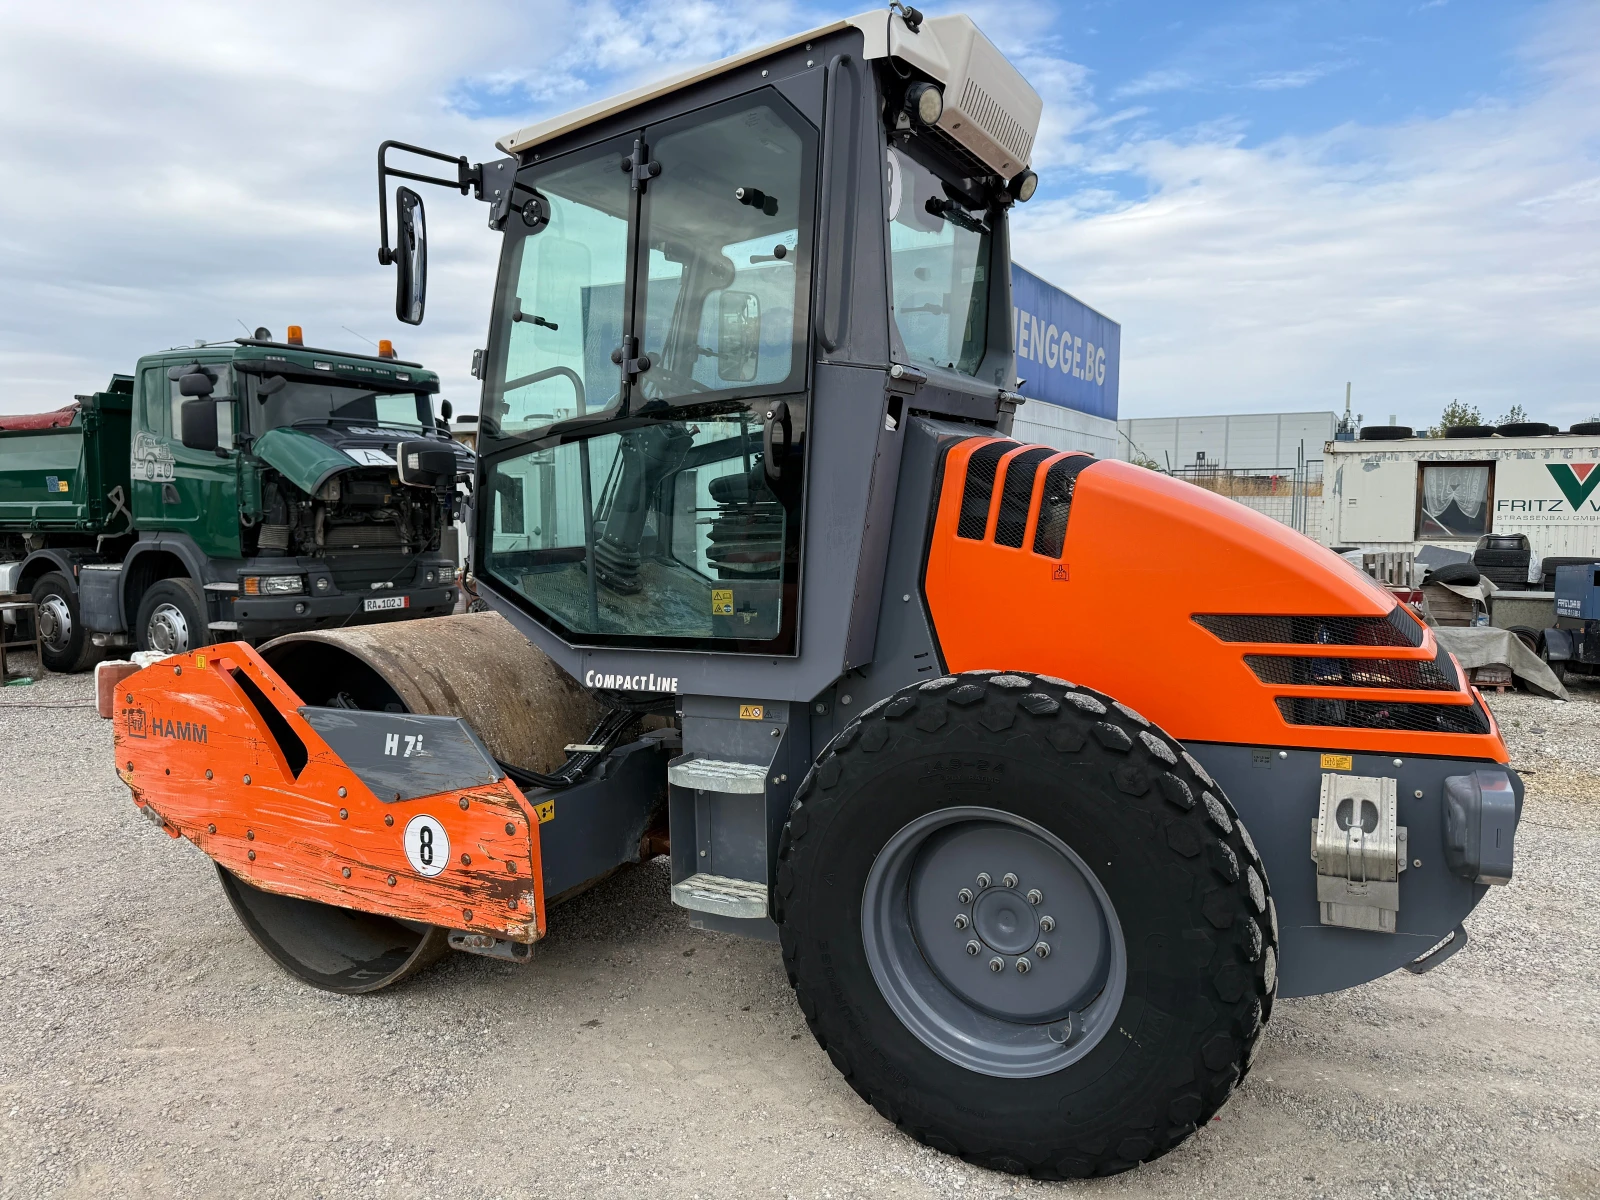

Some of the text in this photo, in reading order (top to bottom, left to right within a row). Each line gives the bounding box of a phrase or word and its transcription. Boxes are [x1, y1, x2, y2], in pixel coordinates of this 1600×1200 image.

[1497, 499, 1564, 512] FRITZ
[152, 717, 208, 744] HAMM
[419, 825, 434, 866] 8
